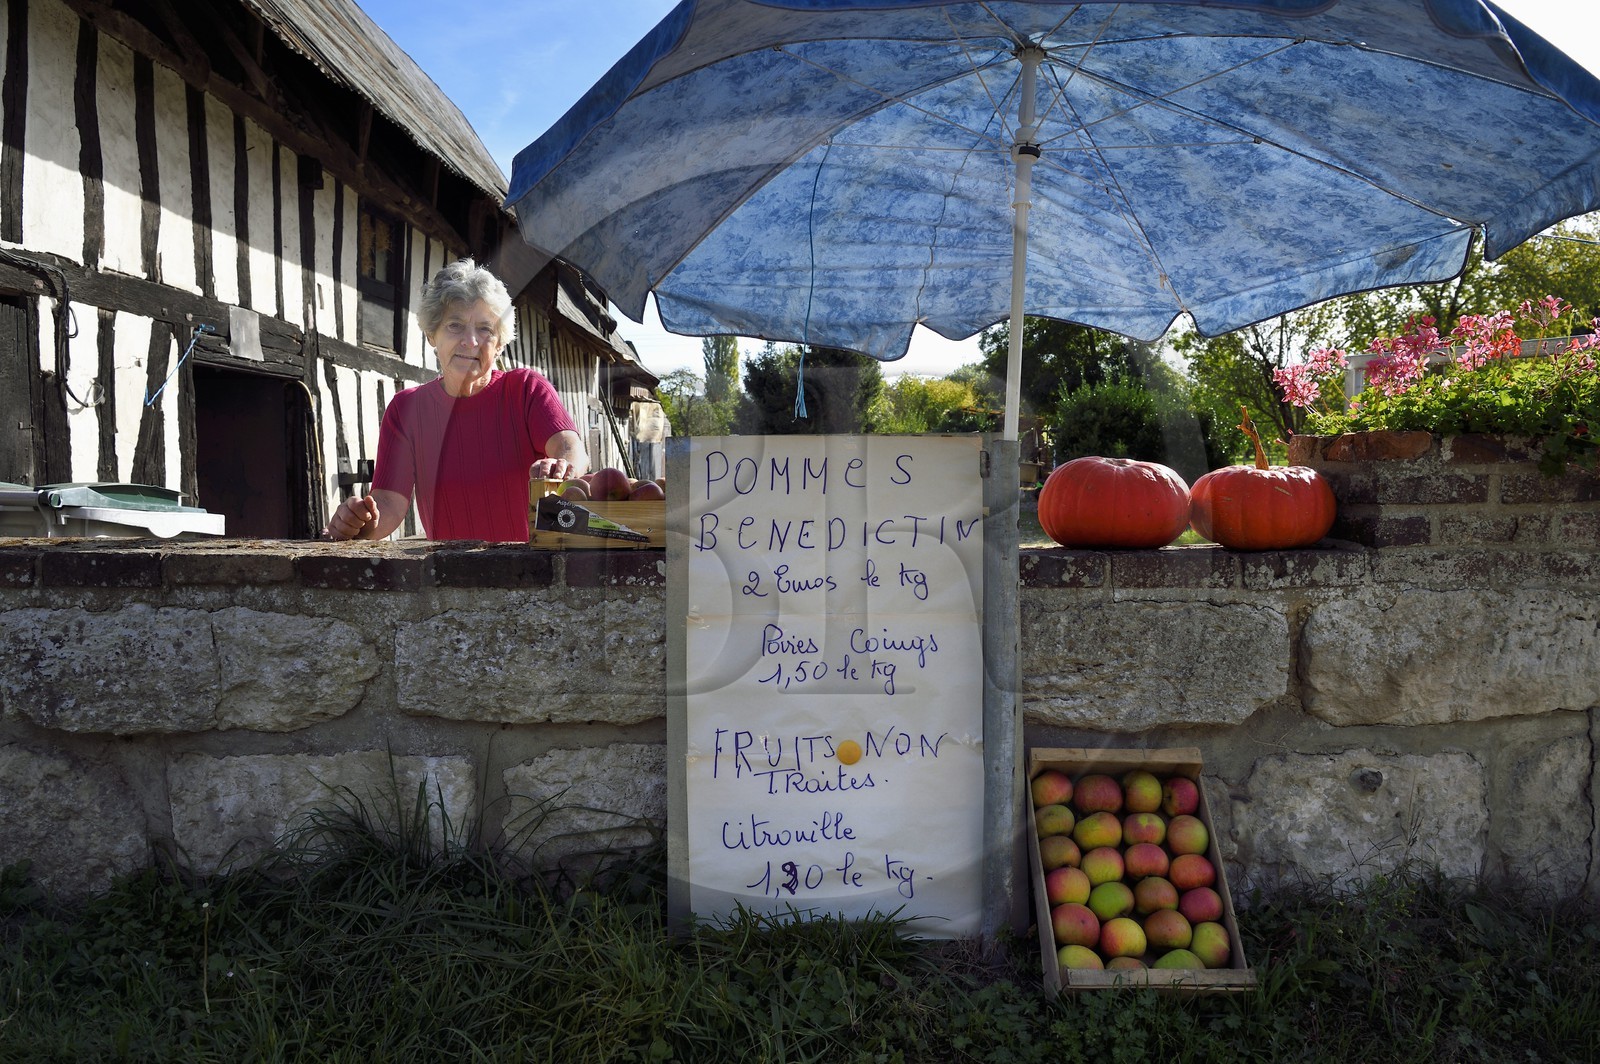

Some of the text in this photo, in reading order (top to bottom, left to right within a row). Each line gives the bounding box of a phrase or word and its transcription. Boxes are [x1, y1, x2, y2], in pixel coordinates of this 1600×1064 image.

[742, 571, 768, 597] 2
[773, 564, 838, 594] Euros
[860, 558, 881, 588] le
[850, 628, 939, 669] Coings
[758, 660, 829, 689] 1,50
[836, 654, 859, 681] le
[713, 725, 949, 779] FRUITS NON
[835, 851, 864, 888] le
